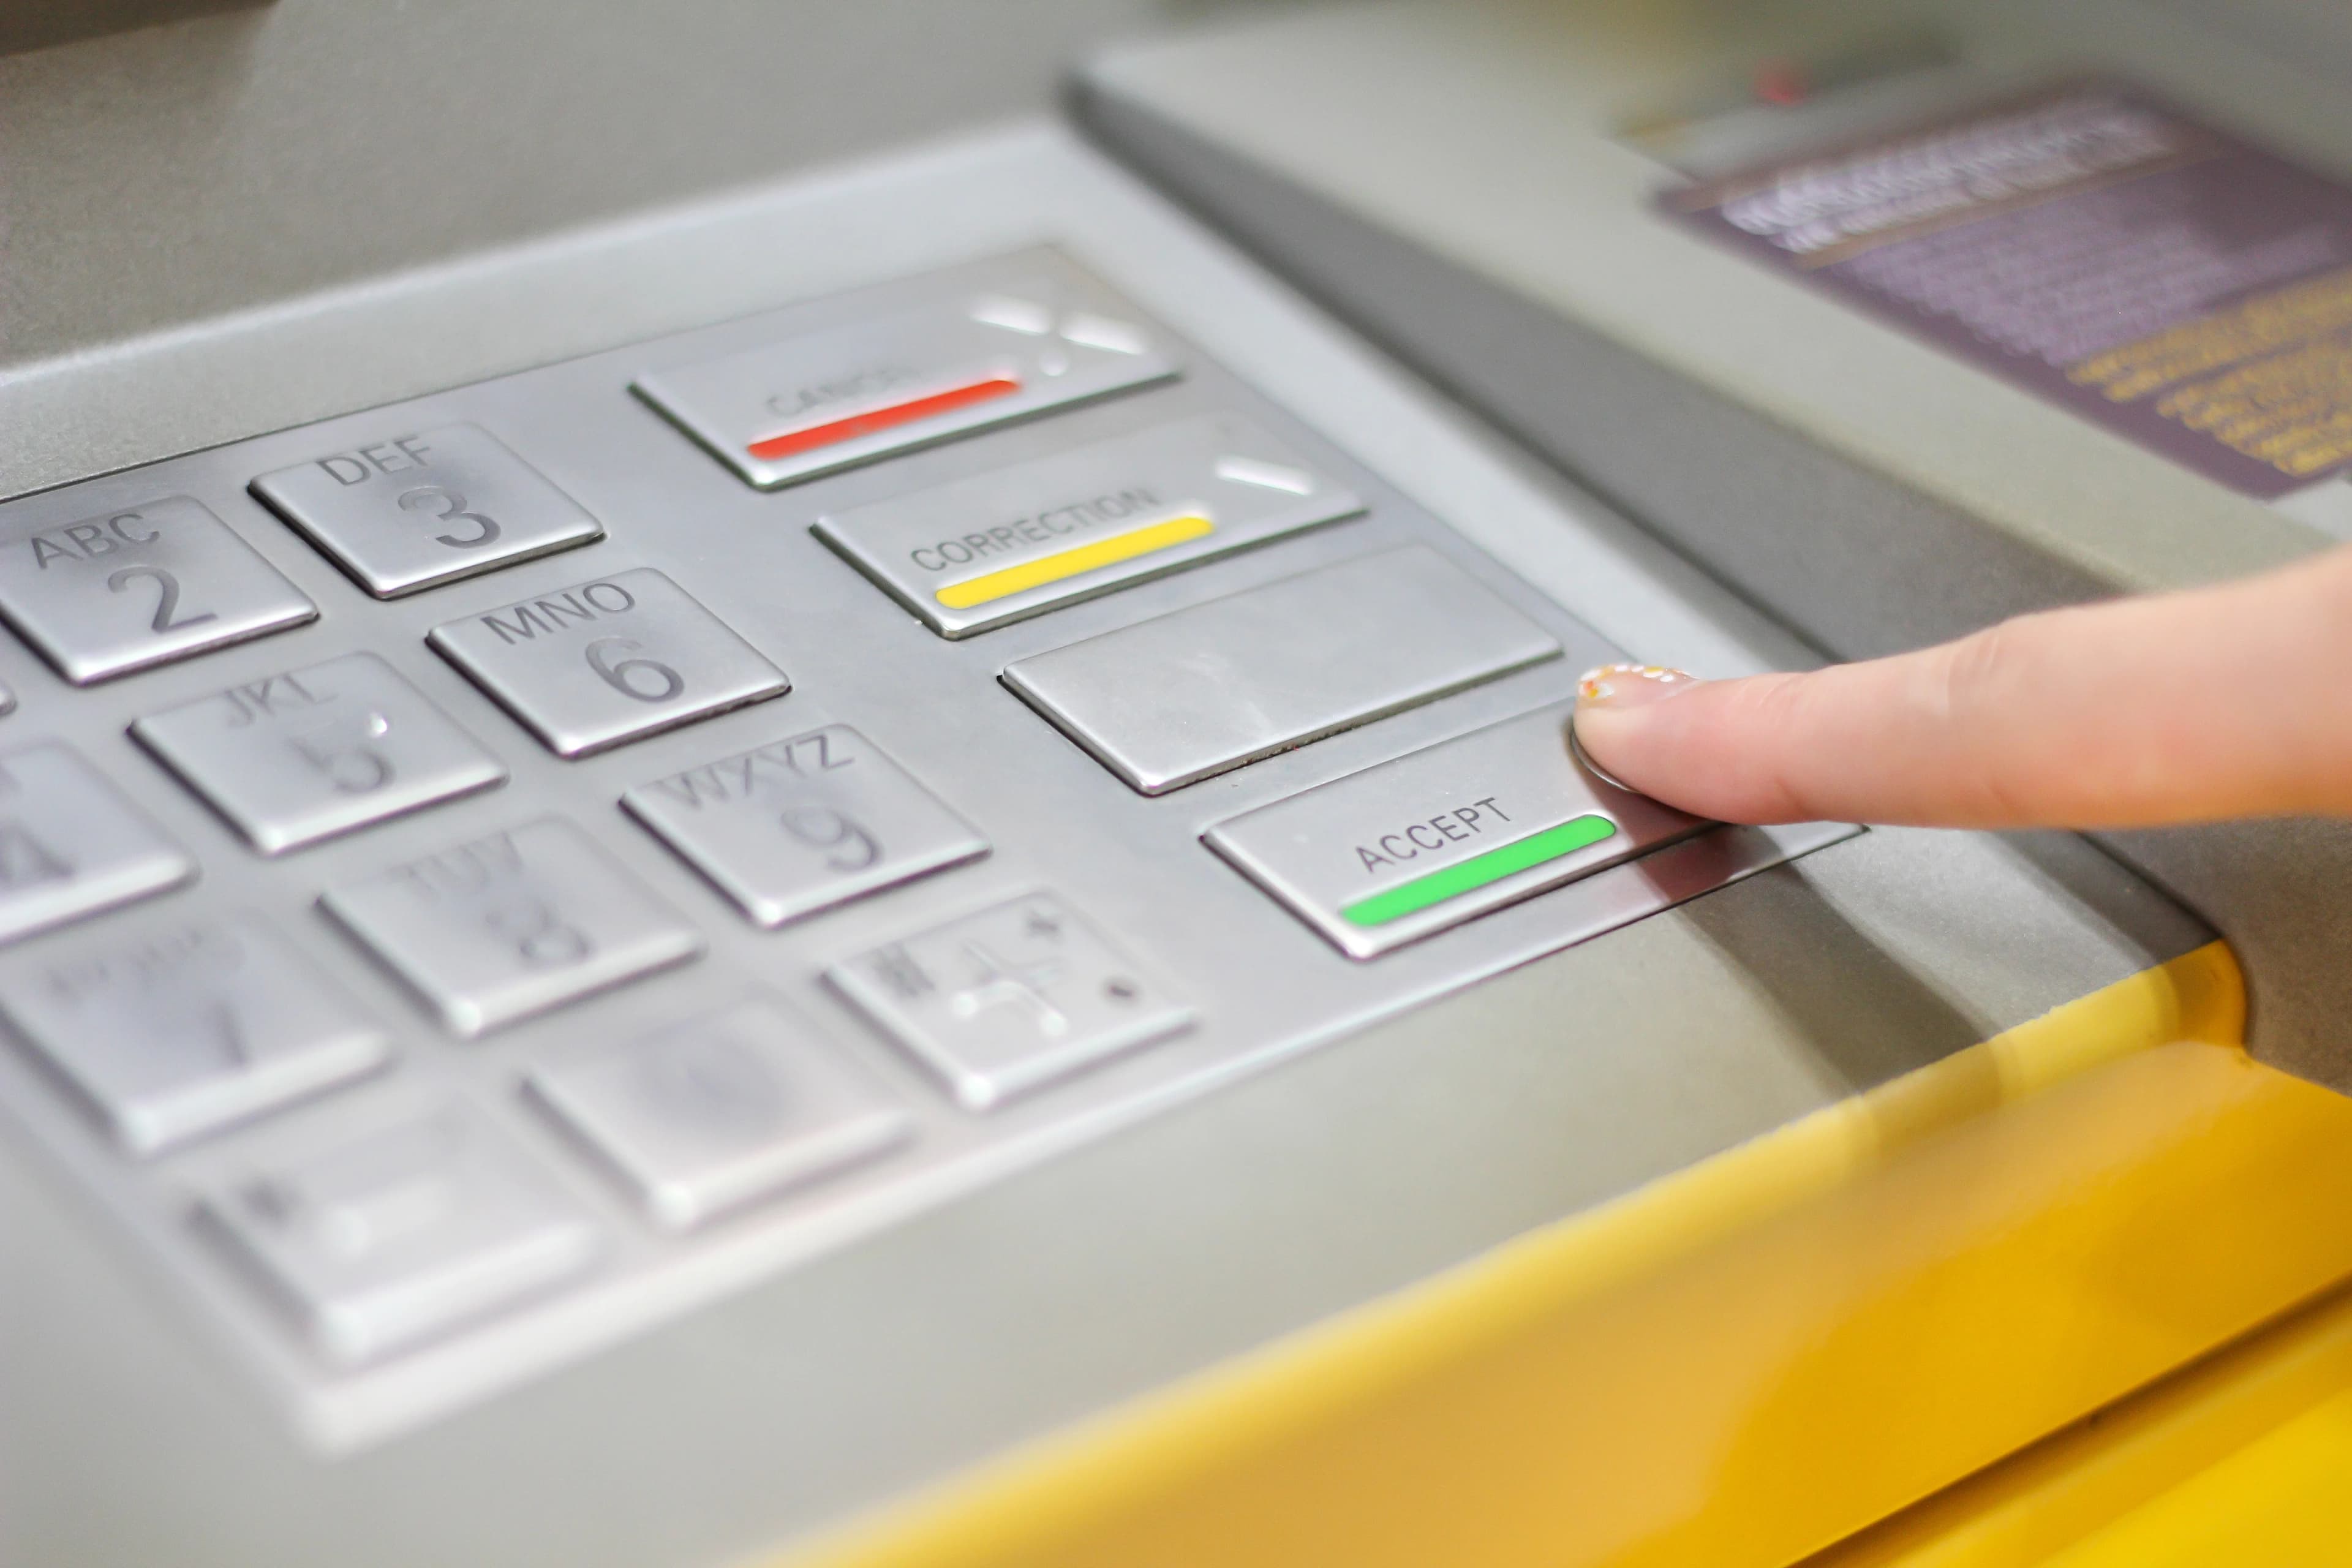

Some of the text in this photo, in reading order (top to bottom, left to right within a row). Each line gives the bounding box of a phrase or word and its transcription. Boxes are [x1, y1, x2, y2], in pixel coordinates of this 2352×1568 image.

[315, 435, 431, 487] DEF
[31, 512, 160, 570] ABC
[398, 484, 502, 549] 3
[910, 486, 1161, 572] CORRECTION
[107, 564, 219, 634] 2
[480, 581, 636, 646] MNO
[584, 635, 685, 704] 6
[650, 733, 856, 811] WXYZ
[779, 804, 886, 873] 9
[1354, 796, 1513, 873] ACCEPT
